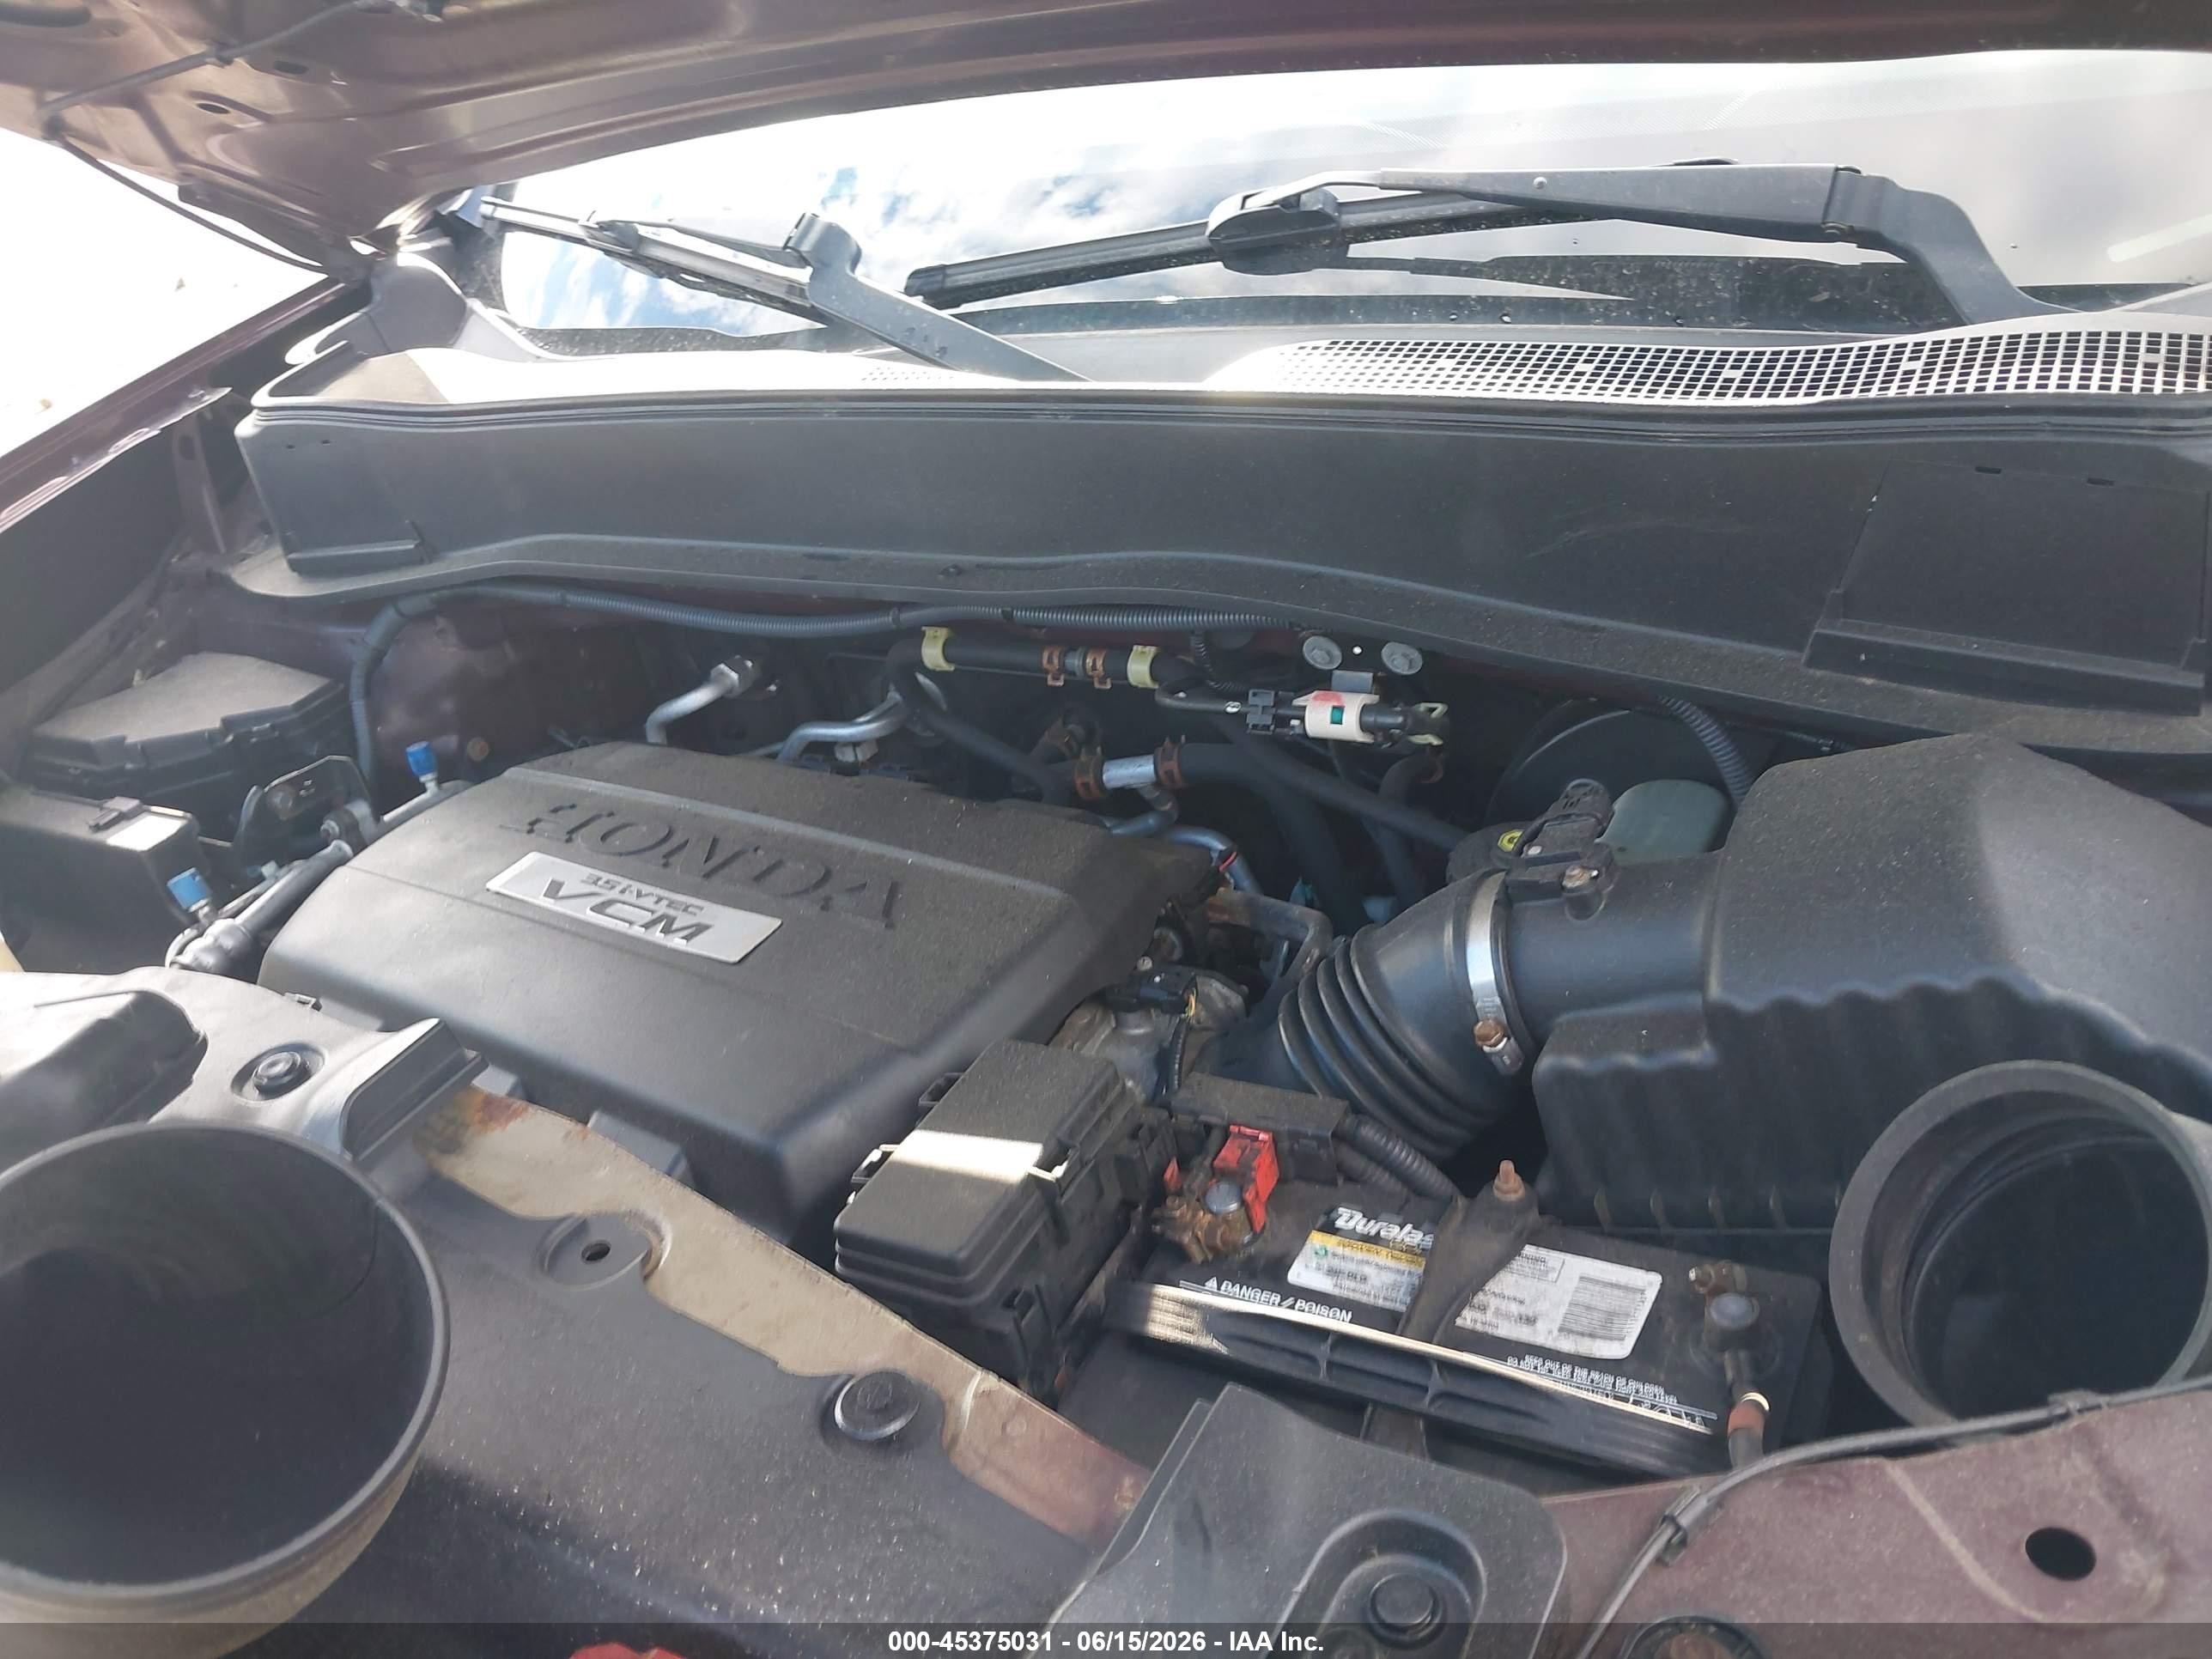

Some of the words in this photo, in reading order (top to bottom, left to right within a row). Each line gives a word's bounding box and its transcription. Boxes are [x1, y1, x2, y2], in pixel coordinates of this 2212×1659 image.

[524, 803, 900, 929] HONDA
[541, 878, 714, 945] VCM
[1334, 1206, 1435, 1250] Duralas
[1219, 1279, 1281, 1308] DANGER
[1294, 1297, 1352, 1323] POISON
